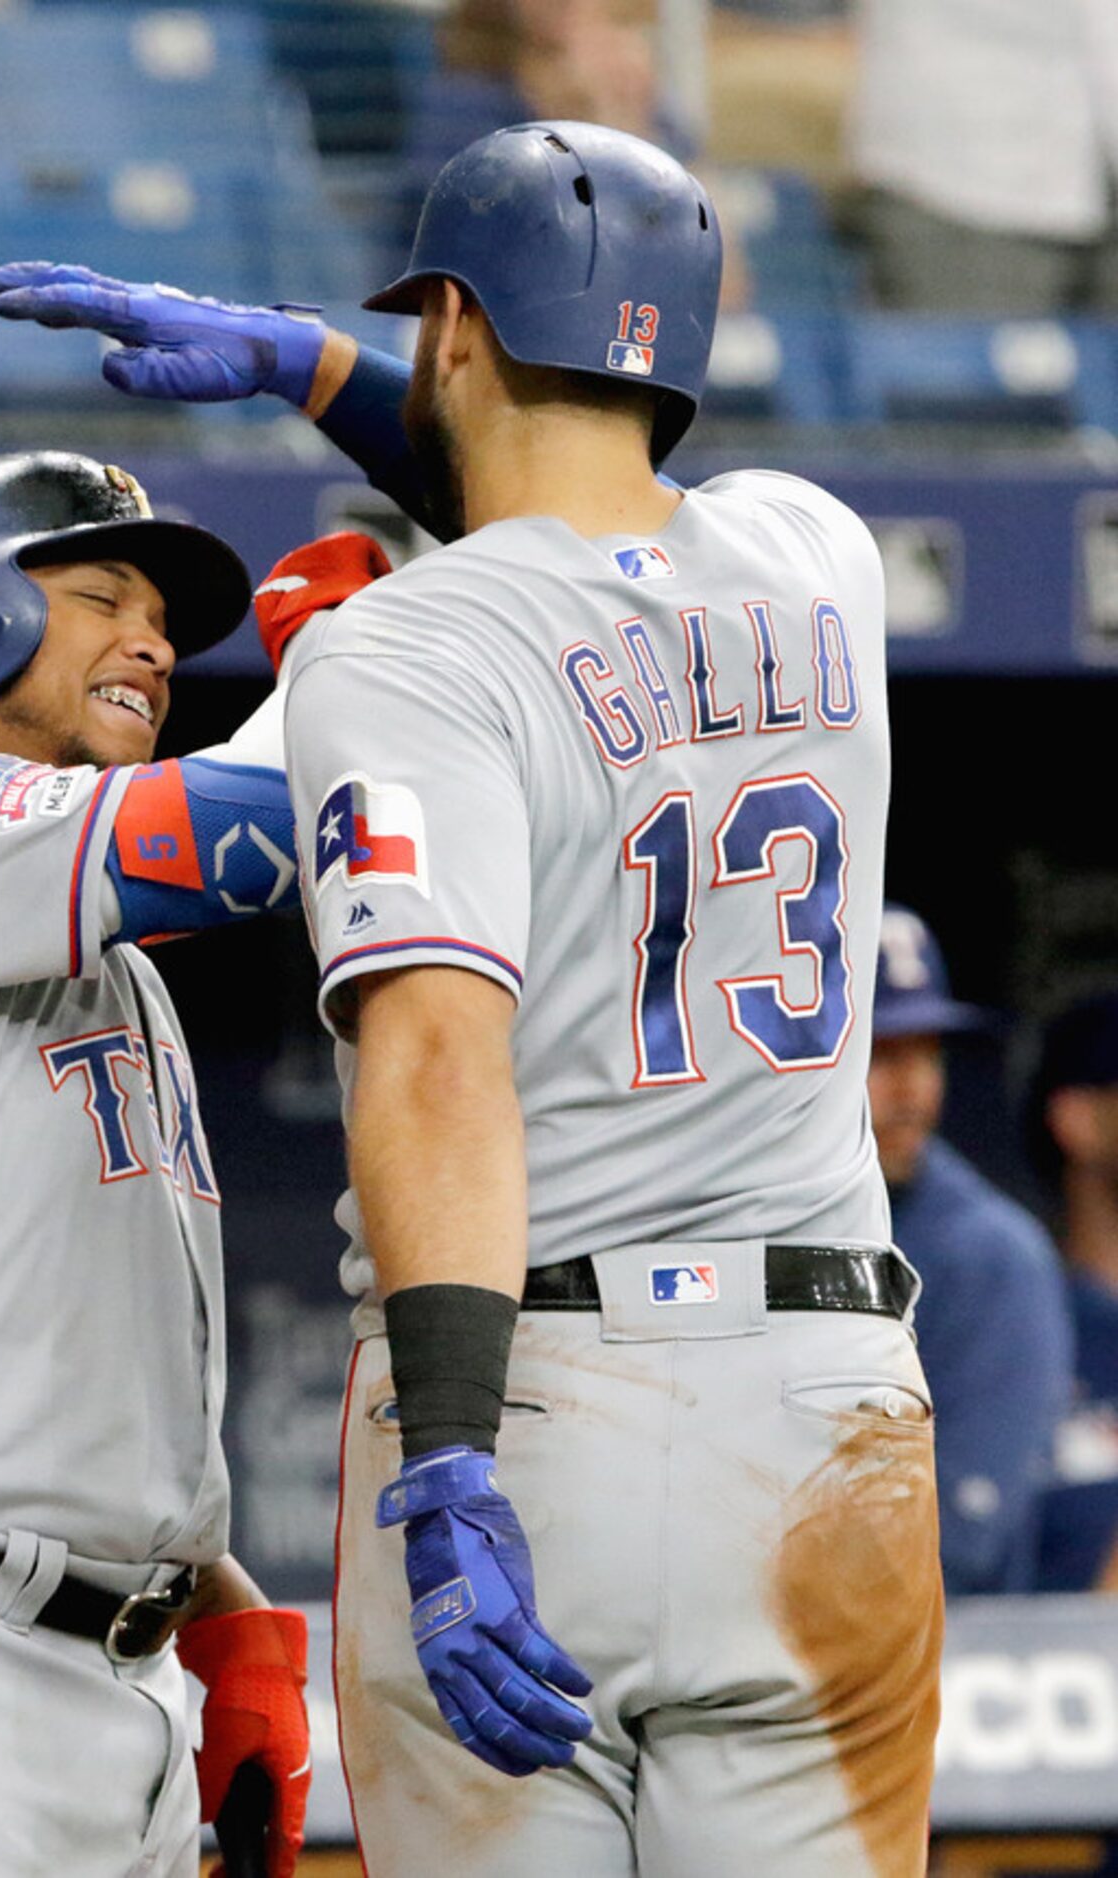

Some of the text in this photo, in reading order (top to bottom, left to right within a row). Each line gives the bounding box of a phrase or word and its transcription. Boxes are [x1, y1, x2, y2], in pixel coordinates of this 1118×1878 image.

[617, 300, 660, 345] 13
[559, 598, 862, 770] GALLO
[136, 834, 179, 860] 5
[623, 771, 856, 1090] 13
[38, 1024, 221, 1207] TX
